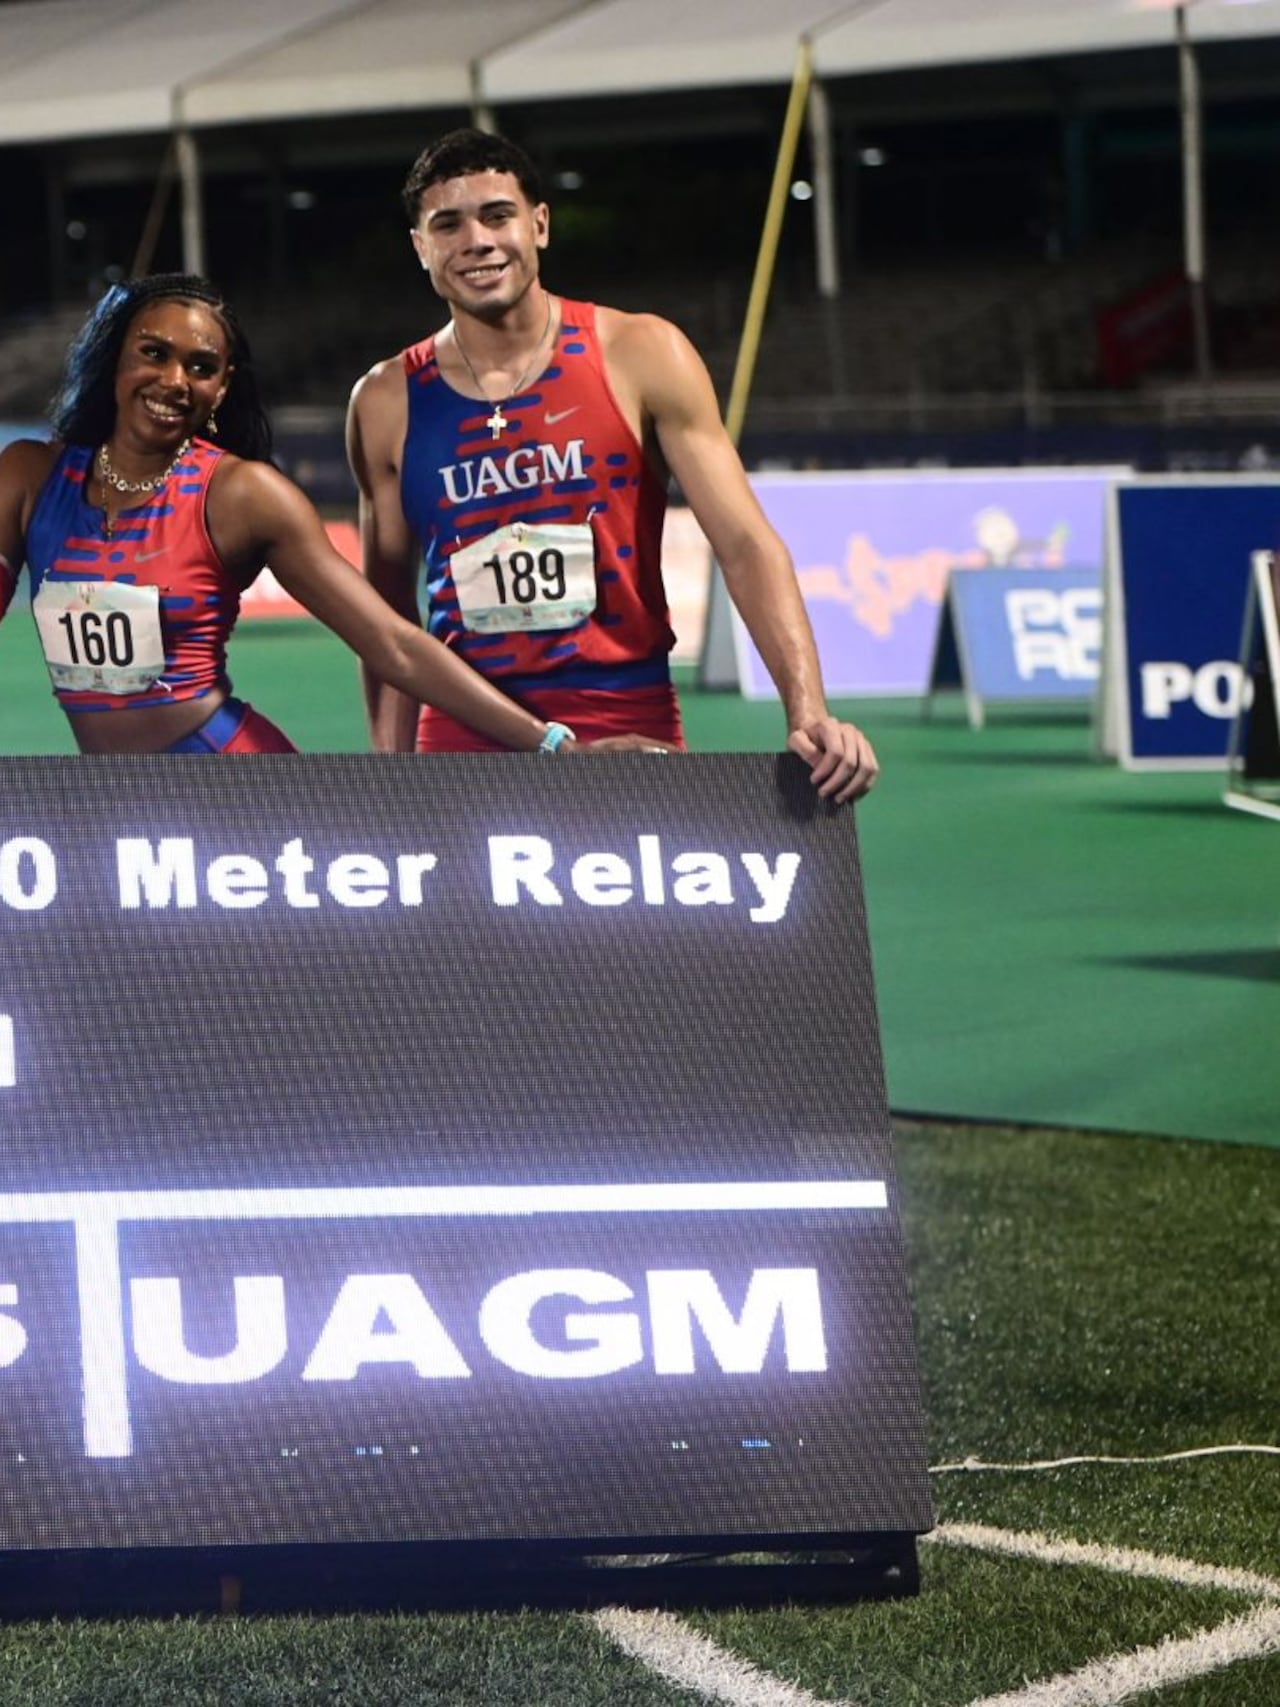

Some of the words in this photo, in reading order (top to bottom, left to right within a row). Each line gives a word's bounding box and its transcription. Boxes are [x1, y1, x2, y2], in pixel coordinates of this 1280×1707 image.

[438, 439, 588, 504] UAGM
[483, 548, 566, 604] 189
[58, 611, 134, 667] 160
[116, 837, 437, 909] Meter
[487, 835, 801, 923] Relay
[130, 1267, 828, 1386] UAGM
